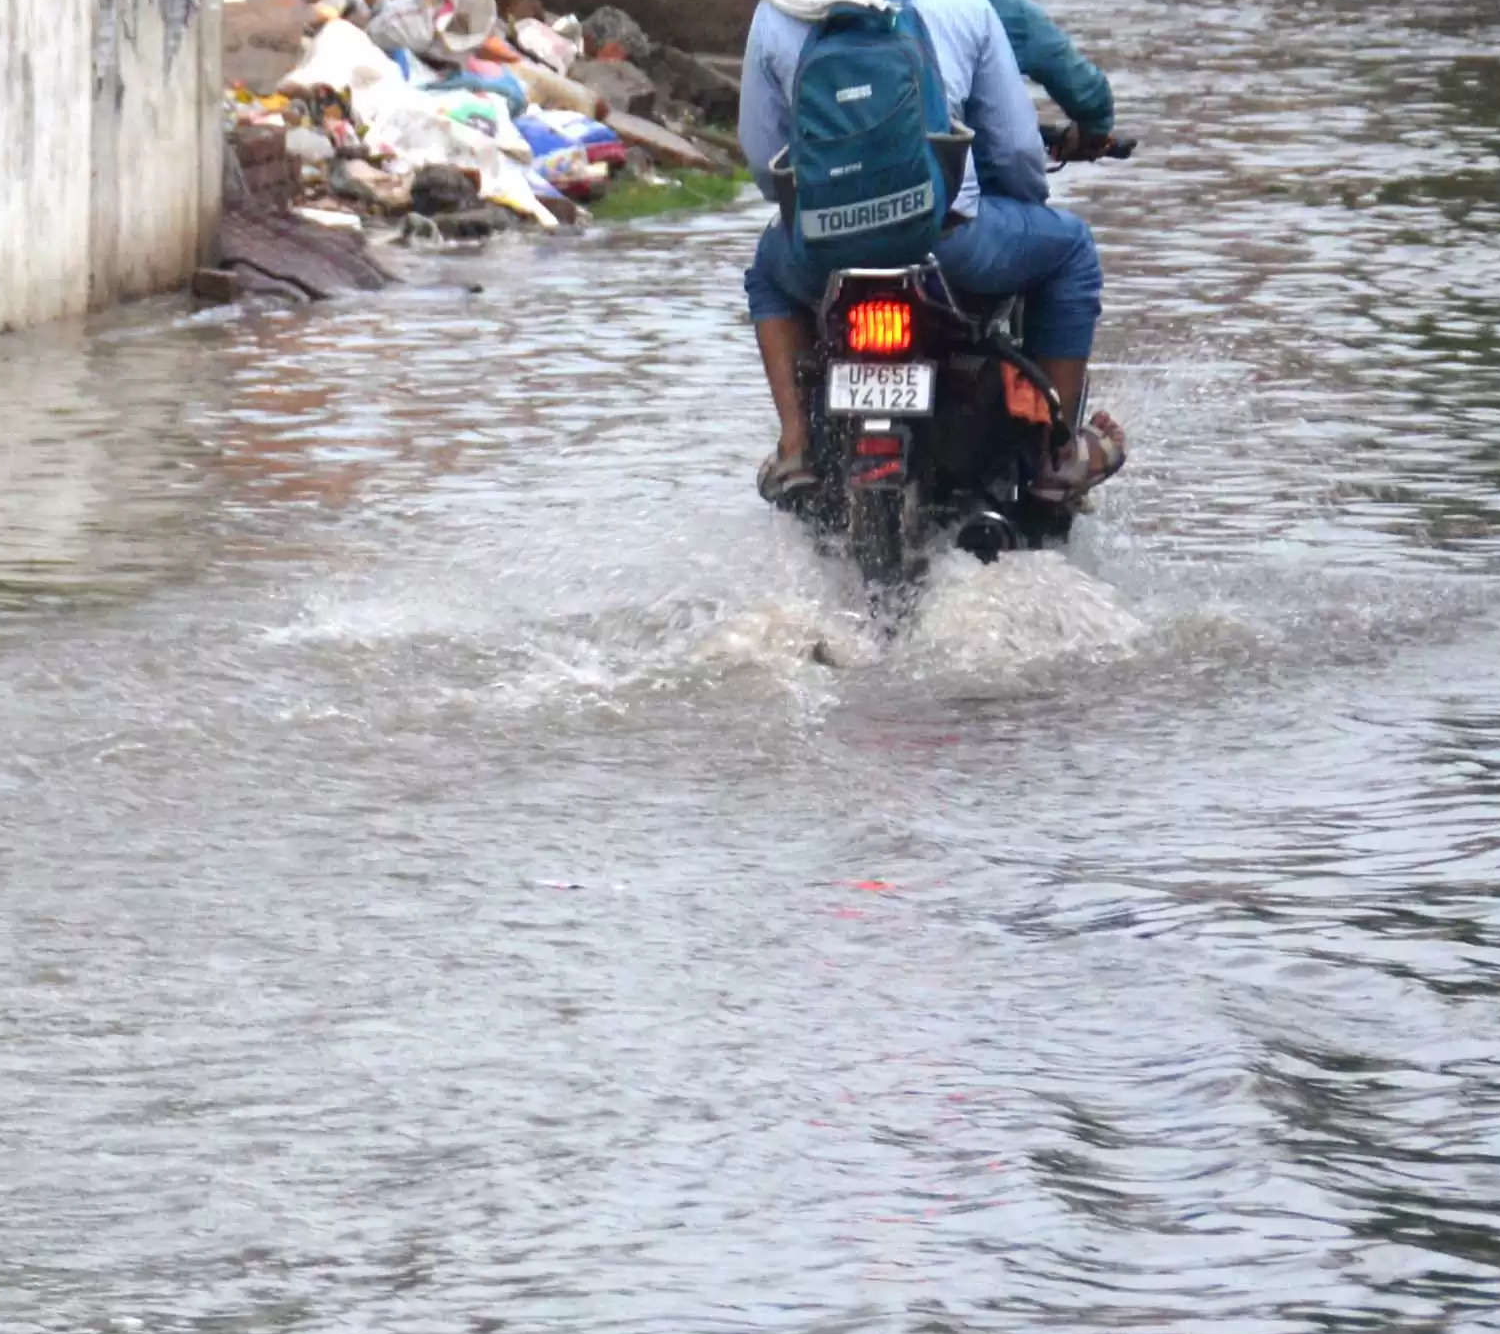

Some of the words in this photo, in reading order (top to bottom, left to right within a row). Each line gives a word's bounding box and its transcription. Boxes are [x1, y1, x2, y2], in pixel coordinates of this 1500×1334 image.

[817, 191, 925, 232] TOURISTER
[849, 366, 919, 386] UP65E
[849, 387, 917, 408] Y4122
